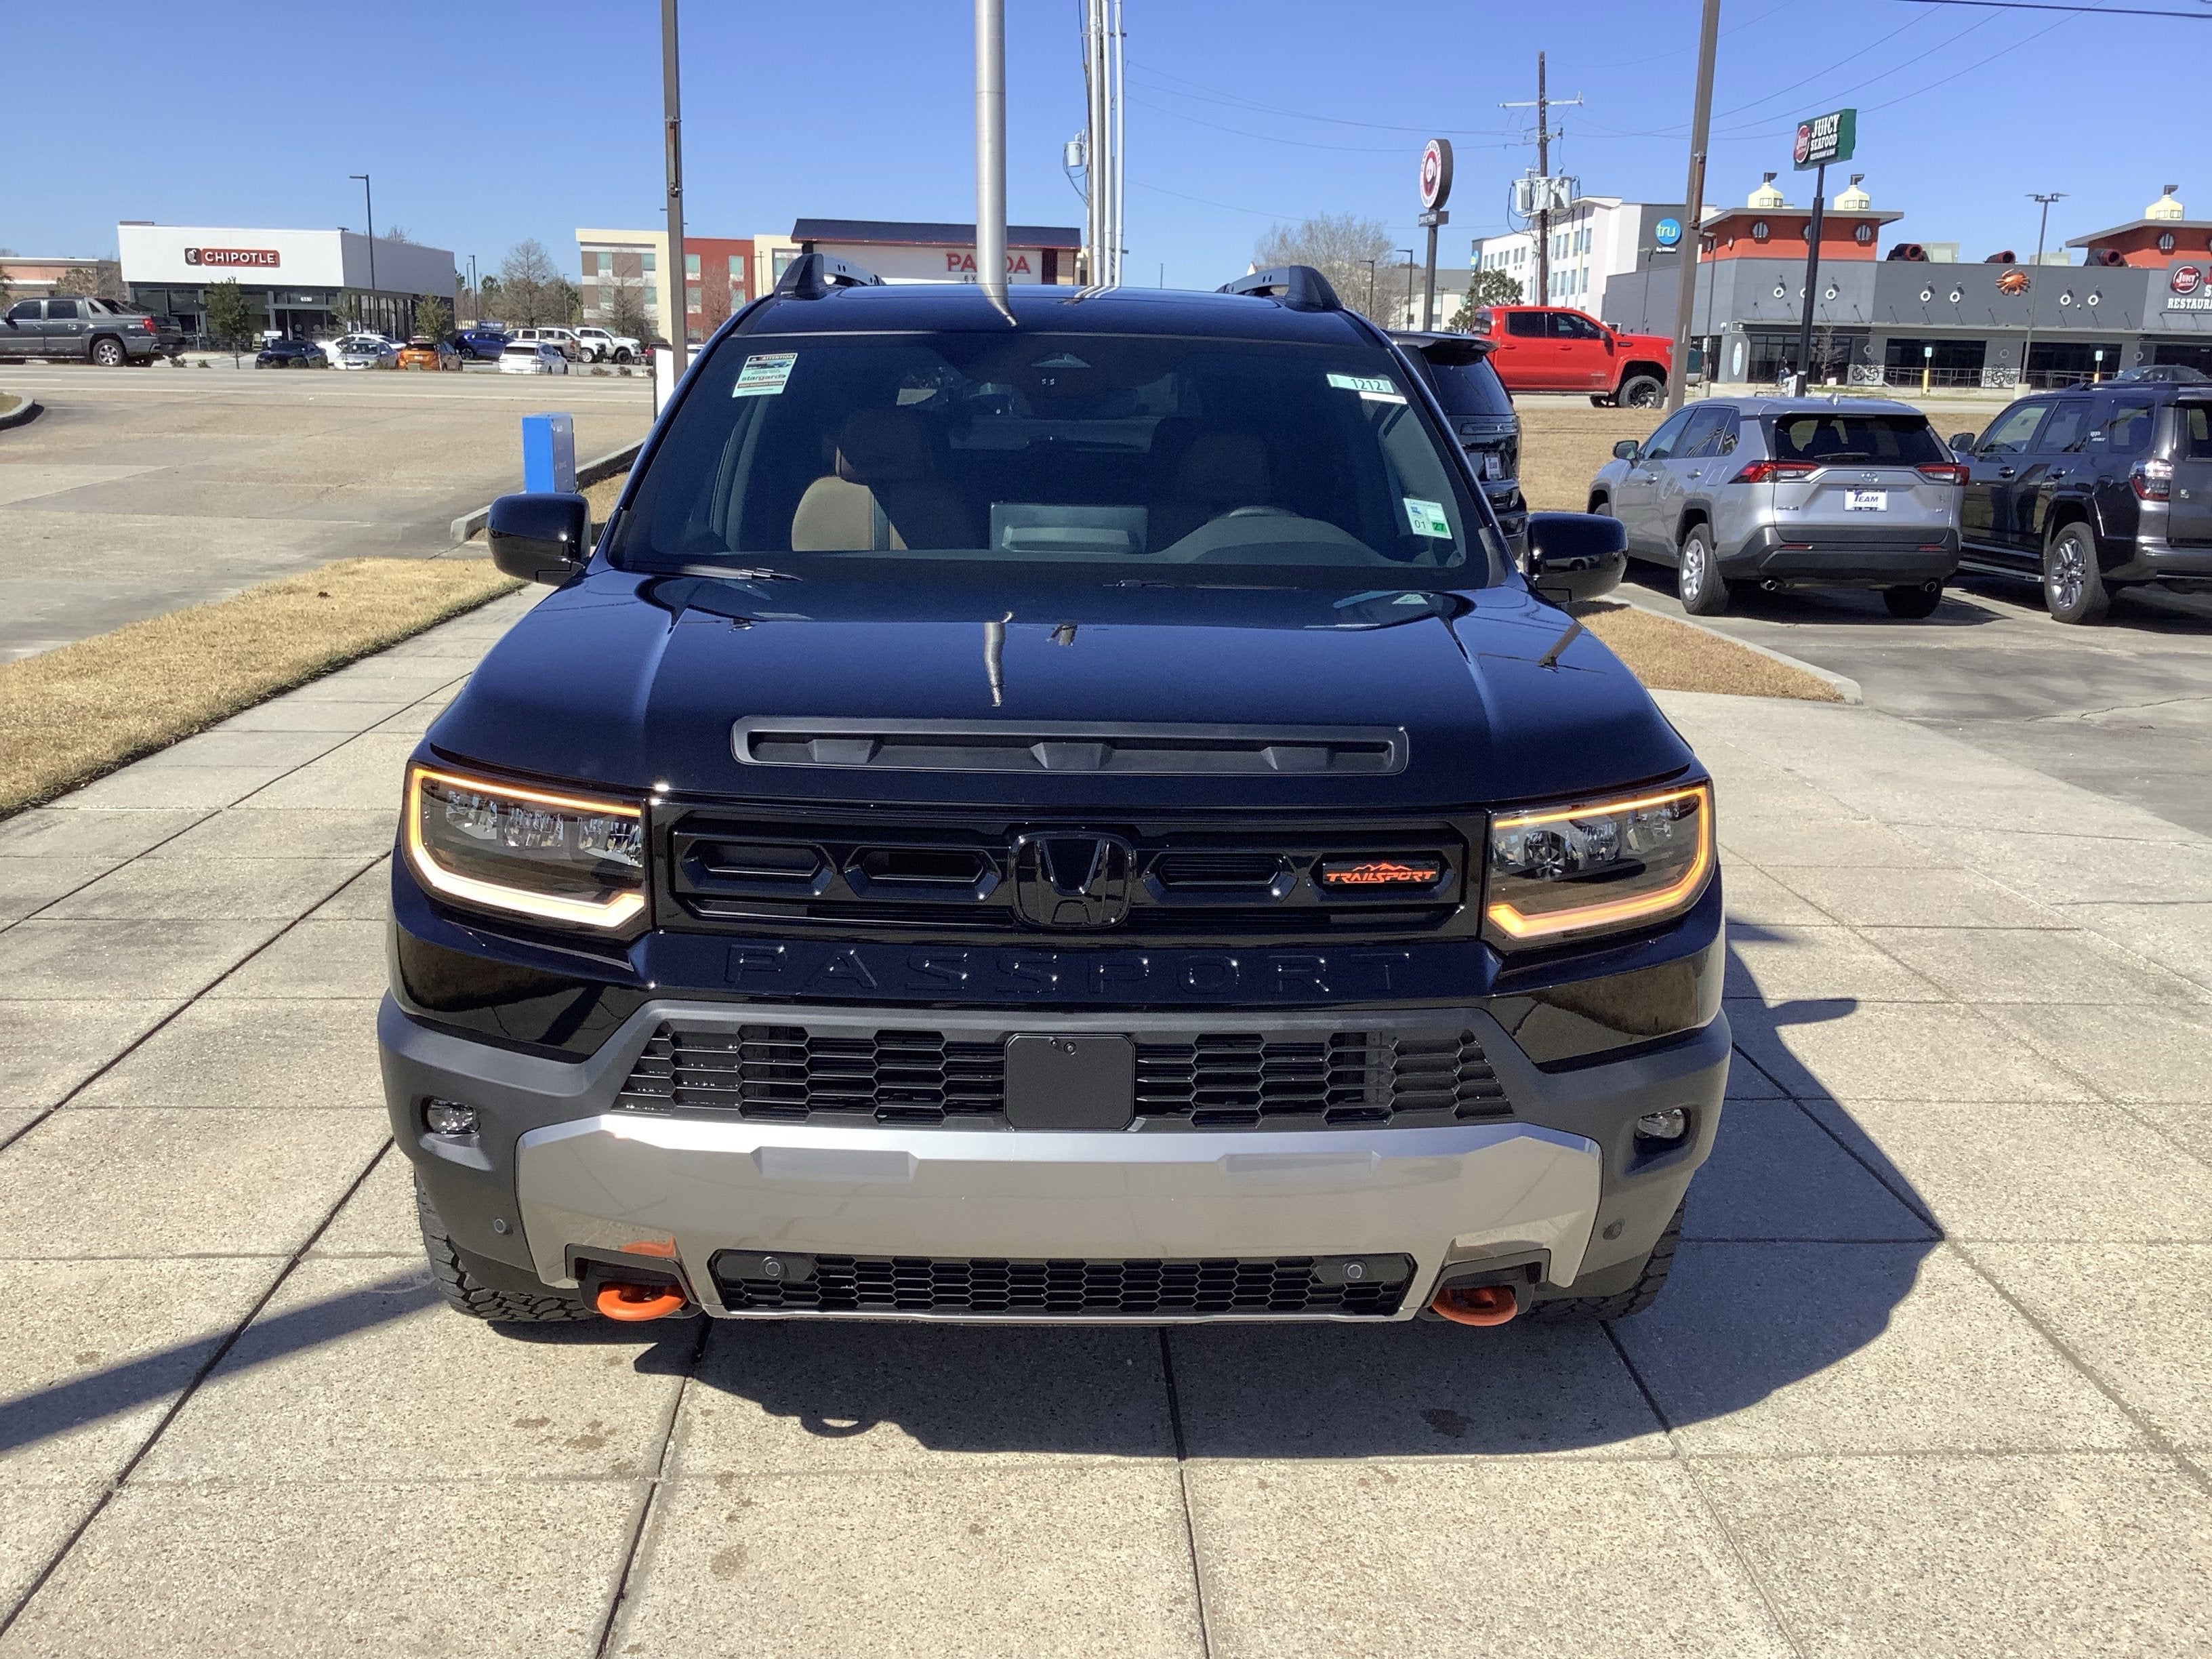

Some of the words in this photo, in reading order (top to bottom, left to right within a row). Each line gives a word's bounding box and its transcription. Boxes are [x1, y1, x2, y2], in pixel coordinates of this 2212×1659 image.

[1811, 114, 1840, 138] JUICY
[1810, 133, 1837, 151] SEAFOOD
[1656, 224, 1676, 237] tru
[205, 252, 275, 264] CHIPOTLE
[946, 253, 1031, 274] PAA
[2167, 298, 2212, 309] RESTAUR
[1351, 379, 1383, 390] 1212
[1854, 489, 1879, 502] TEAM
[1414, 520, 1426, 529] 01
[1433, 522, 1444, 531] 27
[1326, 871, 1436, 884] TRAILSPORT
[724, 943, 1410, 995] PASSPORT
